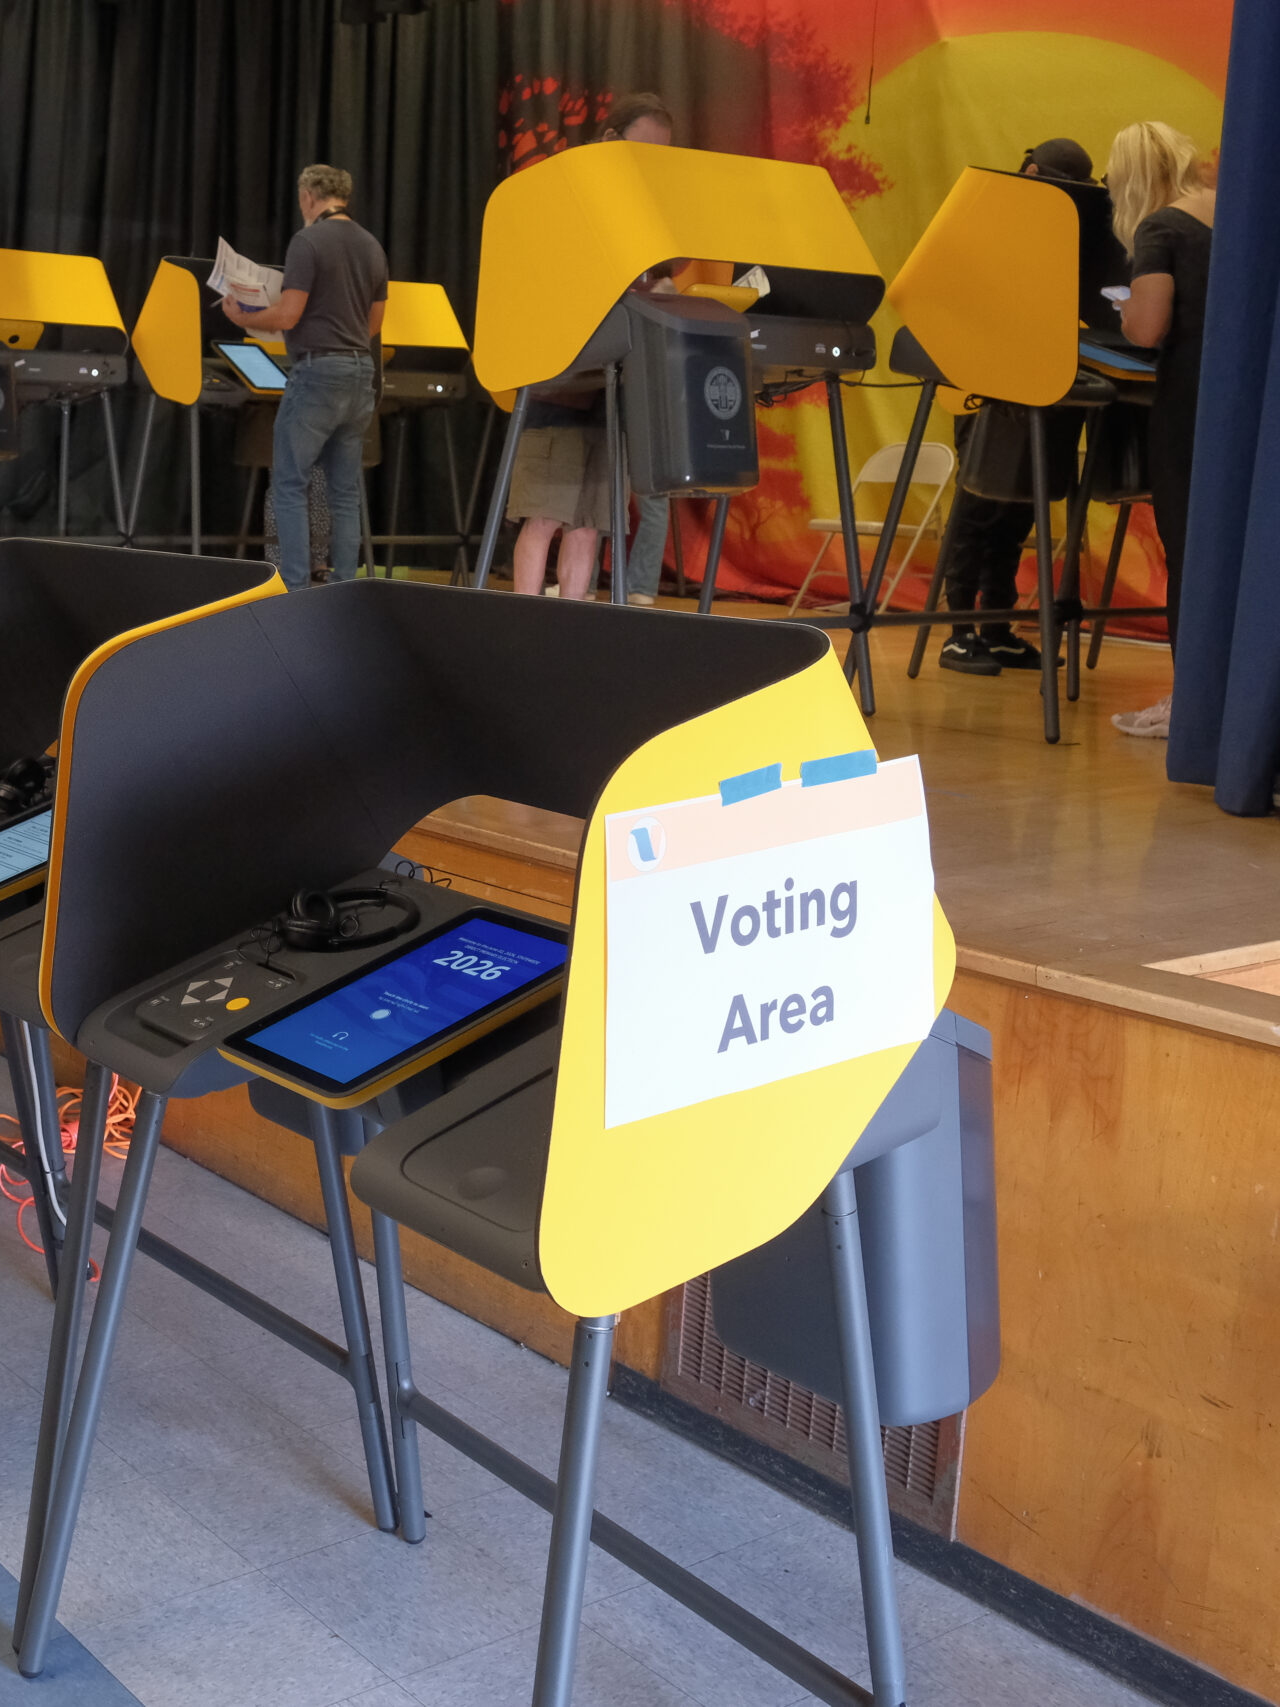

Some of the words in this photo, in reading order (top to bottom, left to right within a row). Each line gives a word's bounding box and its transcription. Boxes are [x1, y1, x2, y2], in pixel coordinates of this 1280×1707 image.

[690, 877, 857, 954] Voting
[433, 950, 511, 980] 2026
[717, 985, 834, 1053] Area
